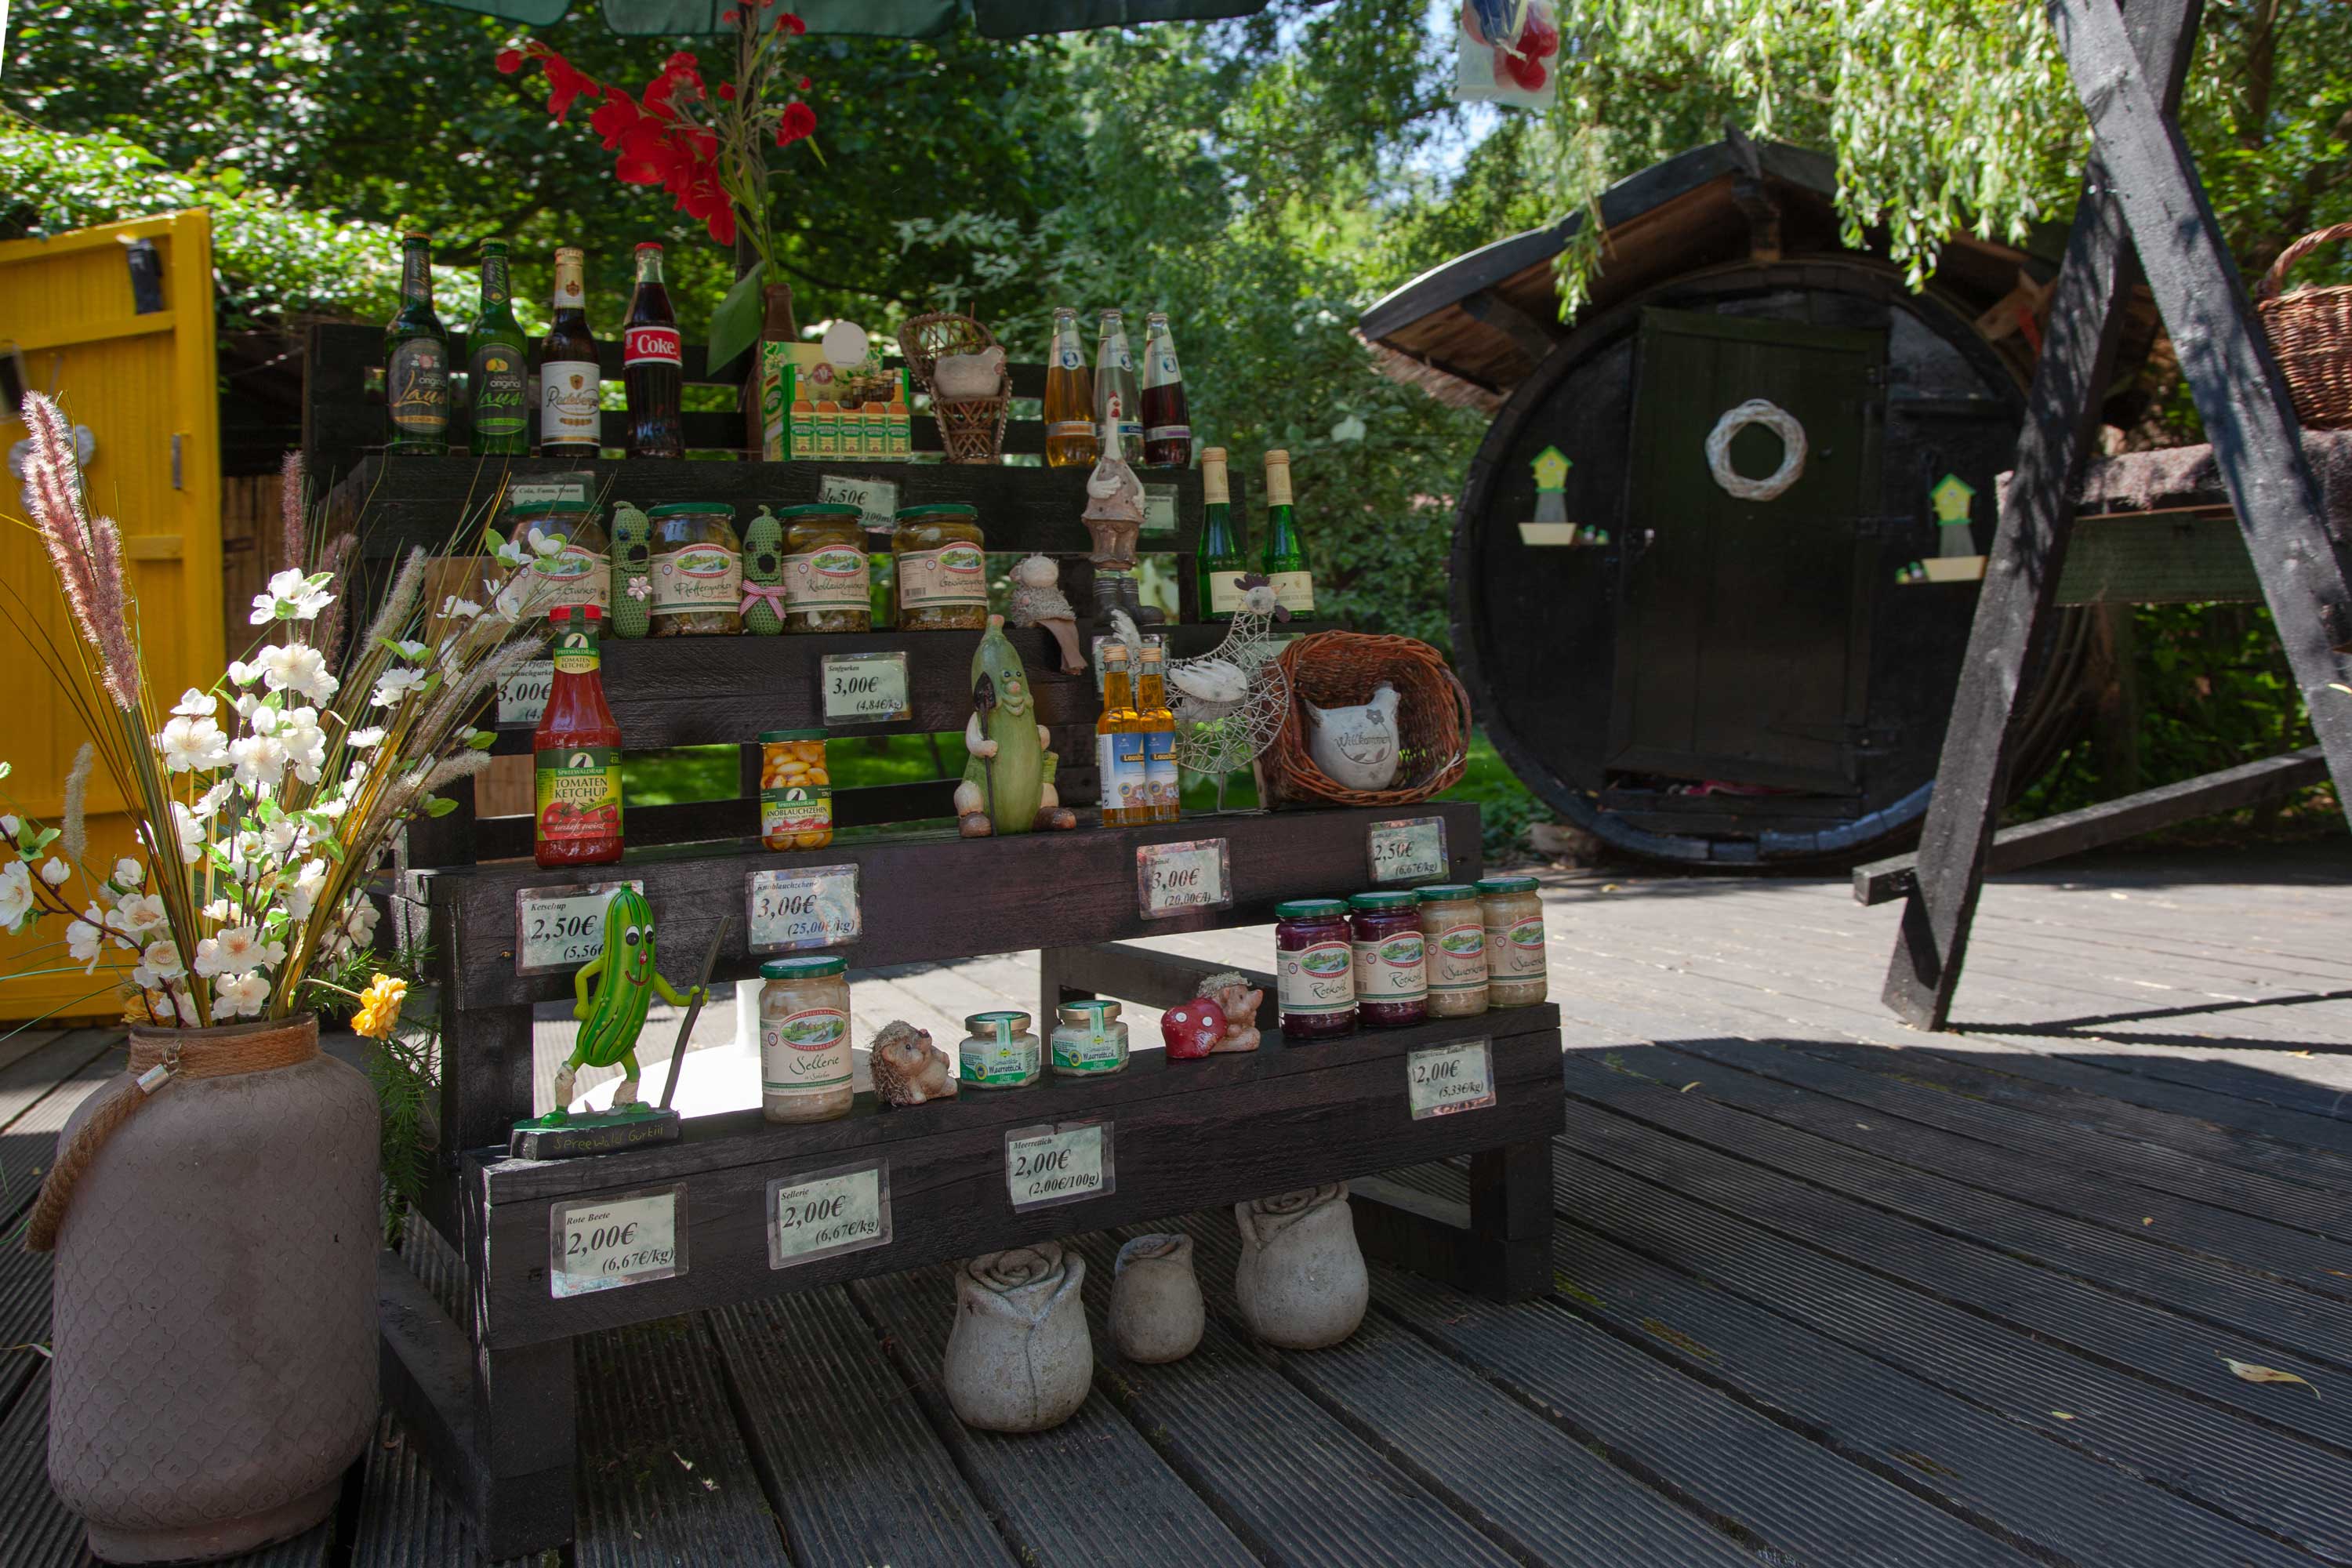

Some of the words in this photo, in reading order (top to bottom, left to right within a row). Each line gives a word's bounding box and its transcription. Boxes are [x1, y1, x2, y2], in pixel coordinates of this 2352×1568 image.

[637, 334, 675, 355] Coke
[833, 676, 879, 696] 3,00€
[555, 787, 608, 799] KETCHUP
[556, 777, 608, 789] TOMATEN
[767, 807, 827, 817] KNOBLAUCHZEHEN
[1374, 841, 1415, 862] 2,50€
[1152, 868, 1200, 891] 3,00€
[1396, 862, 1438, 876] (6,67€/kg)
[531, 902, 567, 912] Ketschup
[757, 895, 817, 920] 3,00€
[532, 915, 598, 942] 2,50€
[1309, 977, 1348, 999] Rotkohl
[789, 1053, 840, 1075] Sellerie
[1417, 1060, 1461, 1085] 2,00€
[1439, 1080, 1484, 1100] (5,33€/kg)
[1014, 1138, 1052, 1149] Meerrettich
[1014, 1149, 1072, 1178] 2,00€
[781, 1188, 809, 1200] Sellerie
[1029, 1172, 1100, 1197] (2,00€/100g)
[566, 1217, 586, 1225] Rote
[588, 1213, 611, 1222] Beete
[782, 1196, 846, 1230] 2,00€
[567, 1222, 638, 1258] 2,00€
[815, 1218, 880, 1246] (6,67€/kg)
[603, 1247, 674, 1275] (6,67€/kg)
